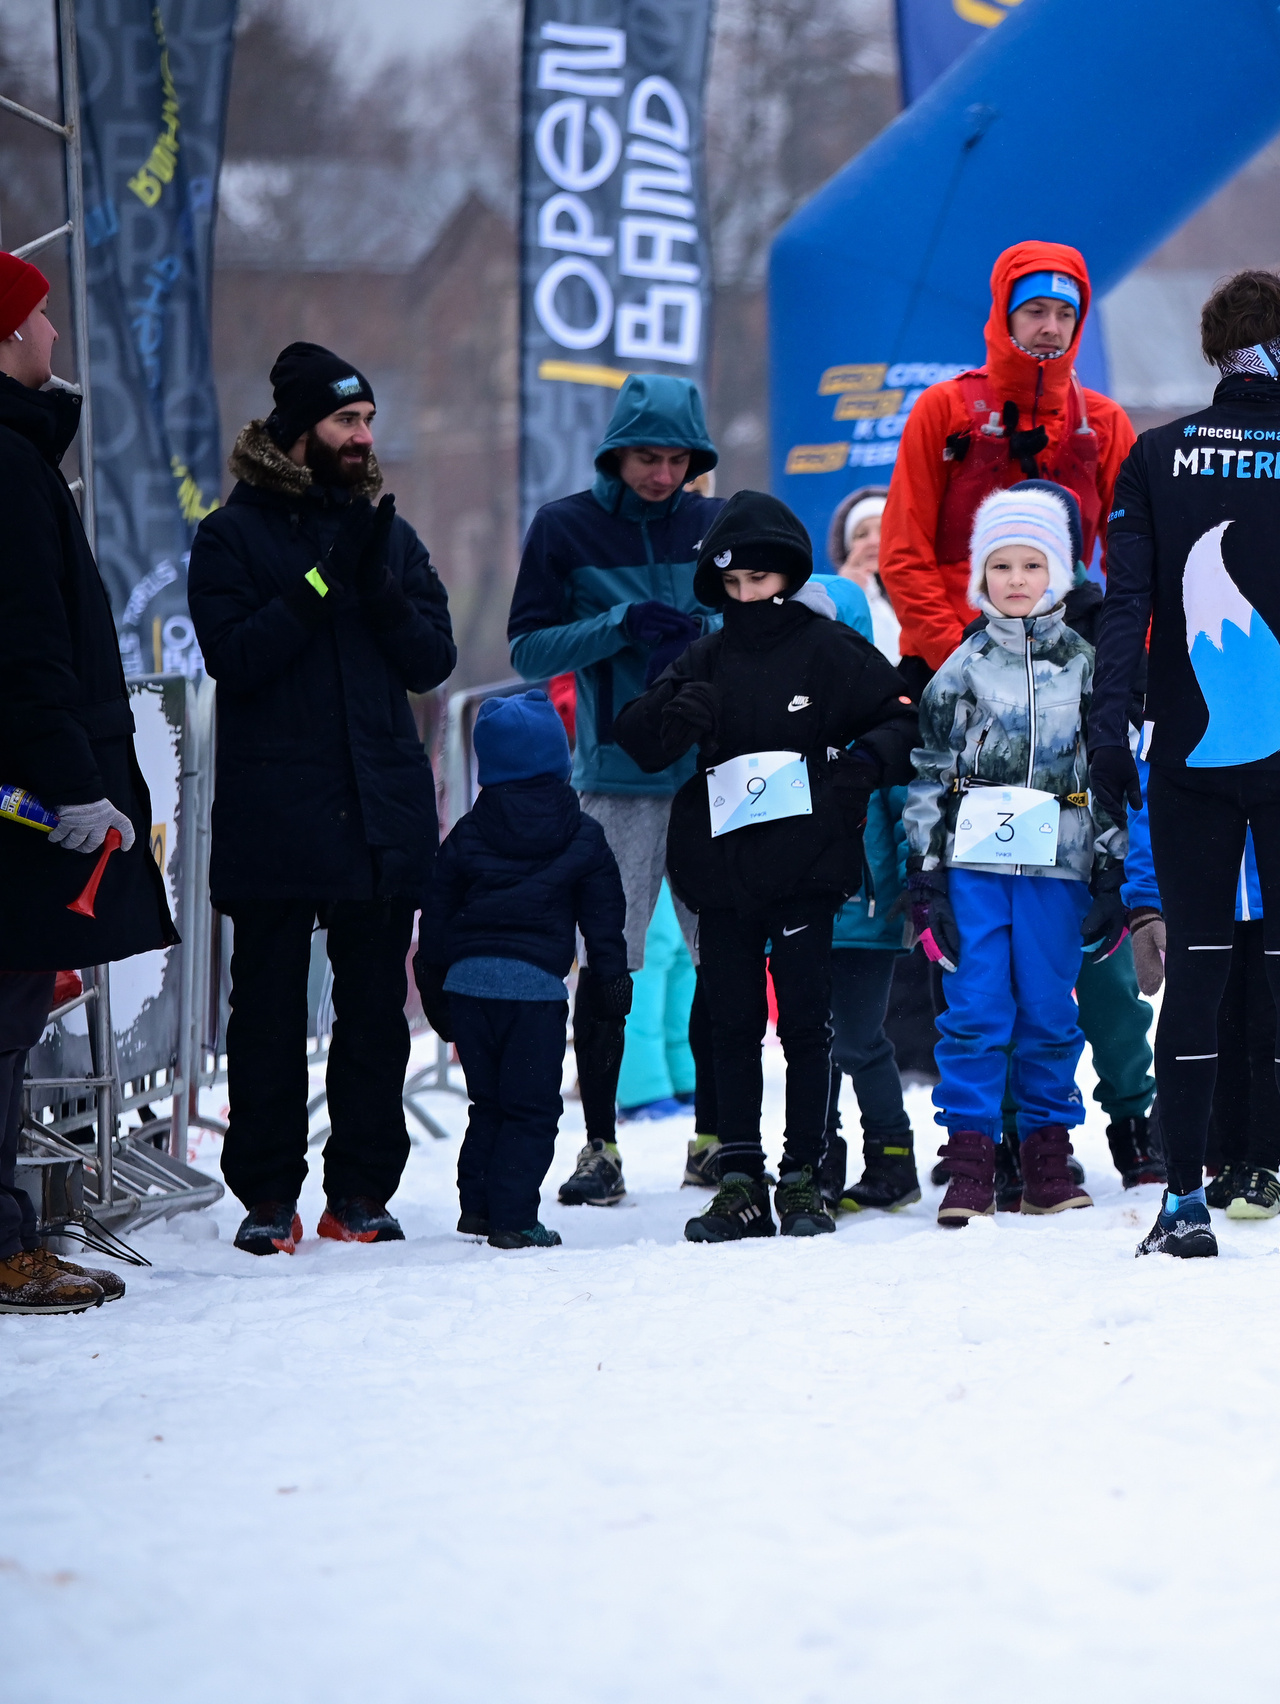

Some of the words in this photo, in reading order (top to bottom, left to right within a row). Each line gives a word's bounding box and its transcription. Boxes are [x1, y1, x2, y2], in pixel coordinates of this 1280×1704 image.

[614, 75, 701, 365] BAND
[792, 694, 810, 705] NIKE
[746, 776, 767, 806] 9
[995, 812, 1015, 842] 3
